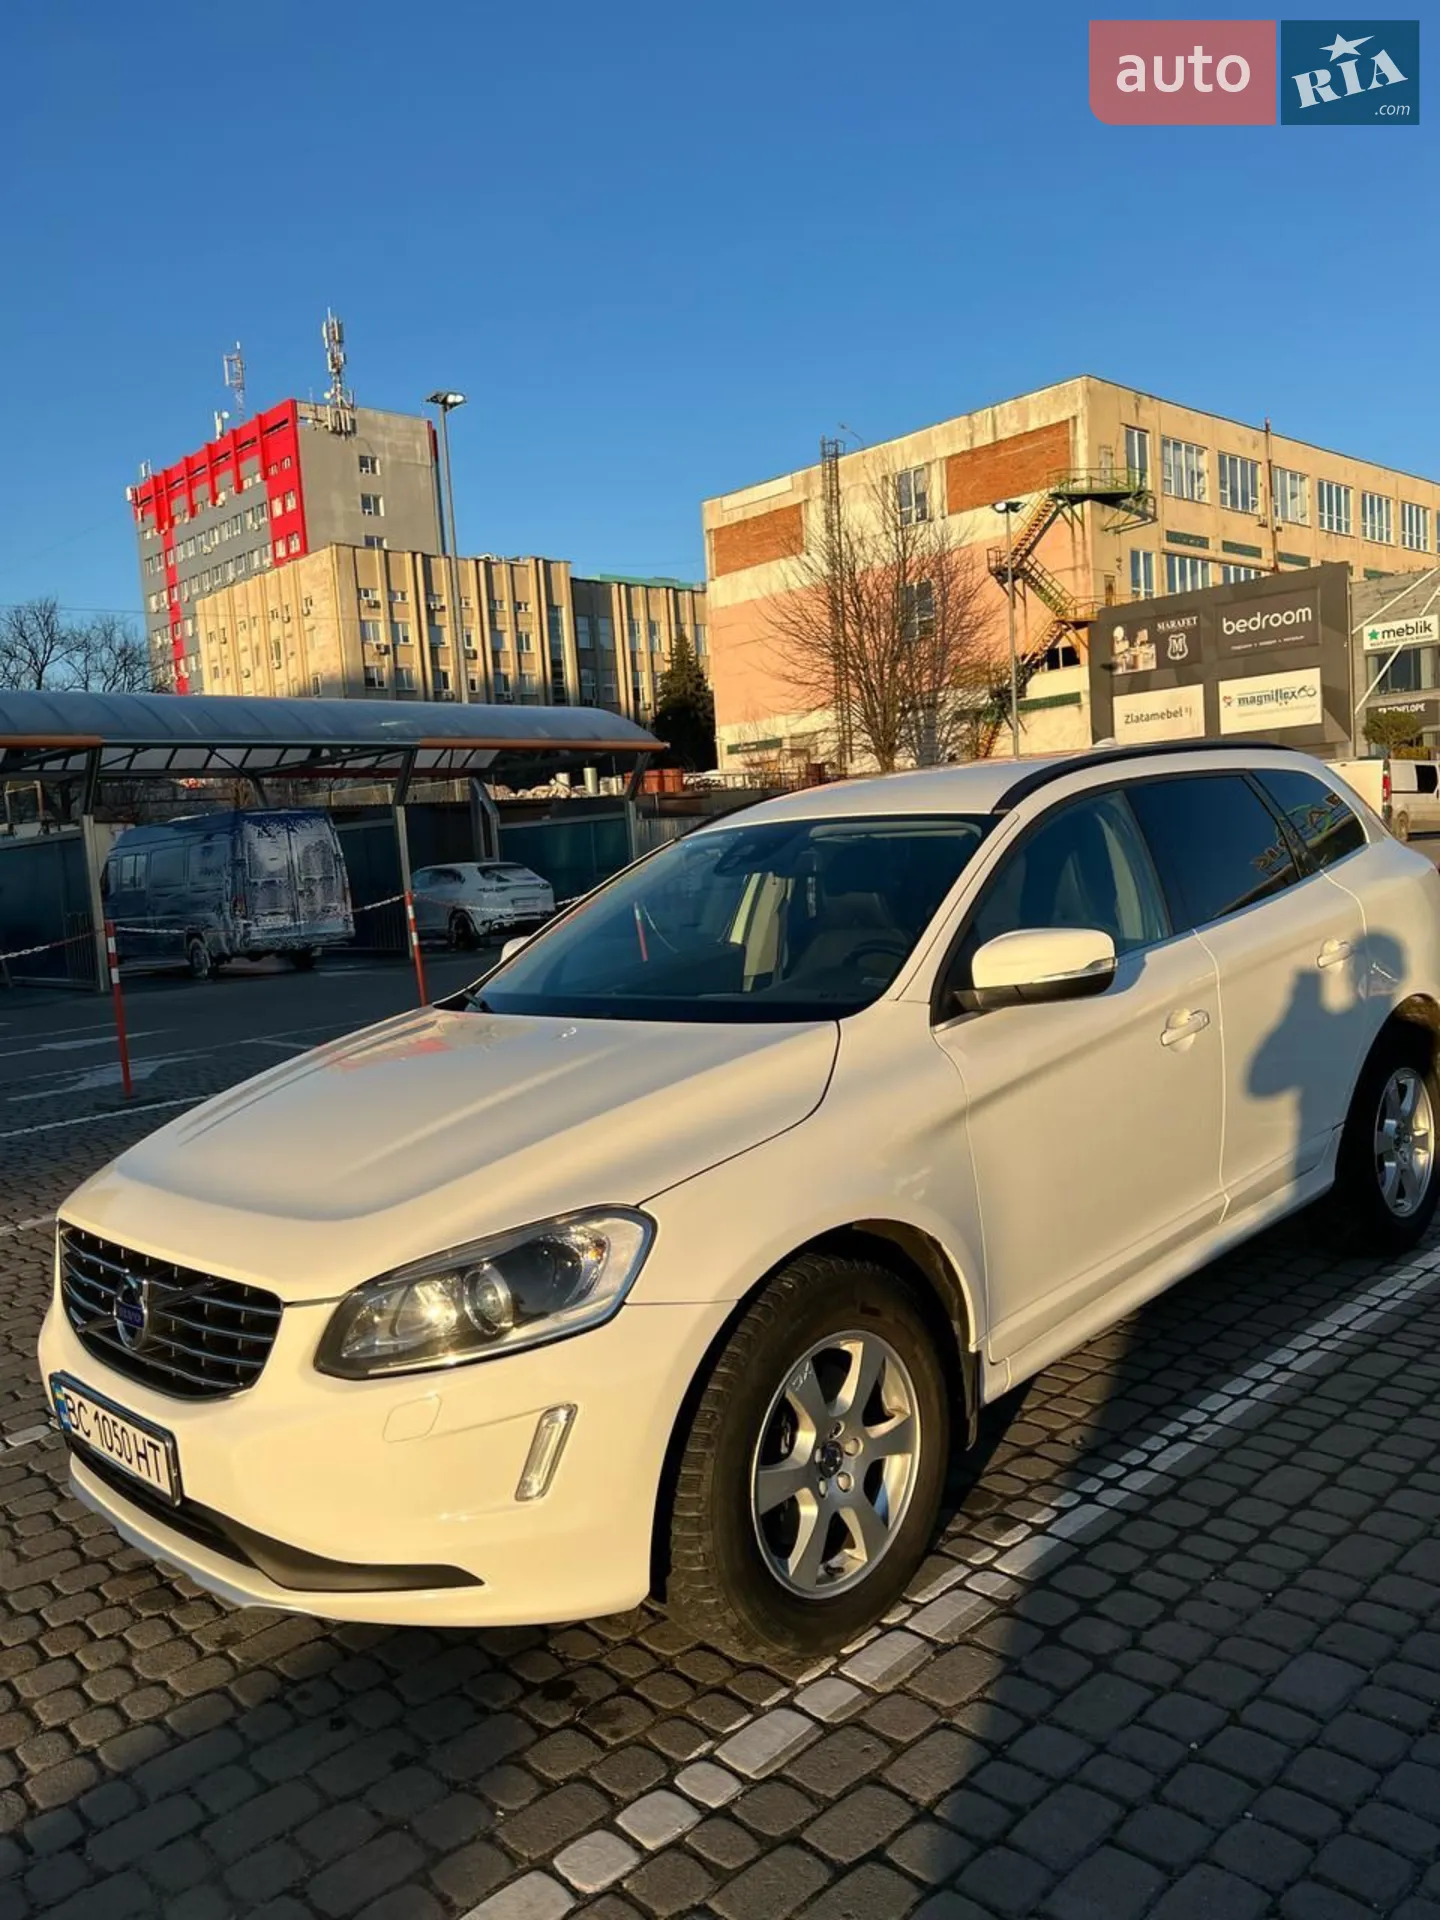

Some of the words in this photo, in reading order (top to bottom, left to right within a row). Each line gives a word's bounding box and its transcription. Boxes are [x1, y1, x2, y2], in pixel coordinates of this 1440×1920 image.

[1222, 607, 1312, 635] bedroom
[1381, 620, 1432, 639] meblik
[1237, 688, 1298, 706] magniflex
[1124, 706, 1184, 724] Zlatamebel
[64, 1393, 91, 1438] BC
[94, 1410, 133, 1465] 1050
[133, 1433, 161, 1483] HT
